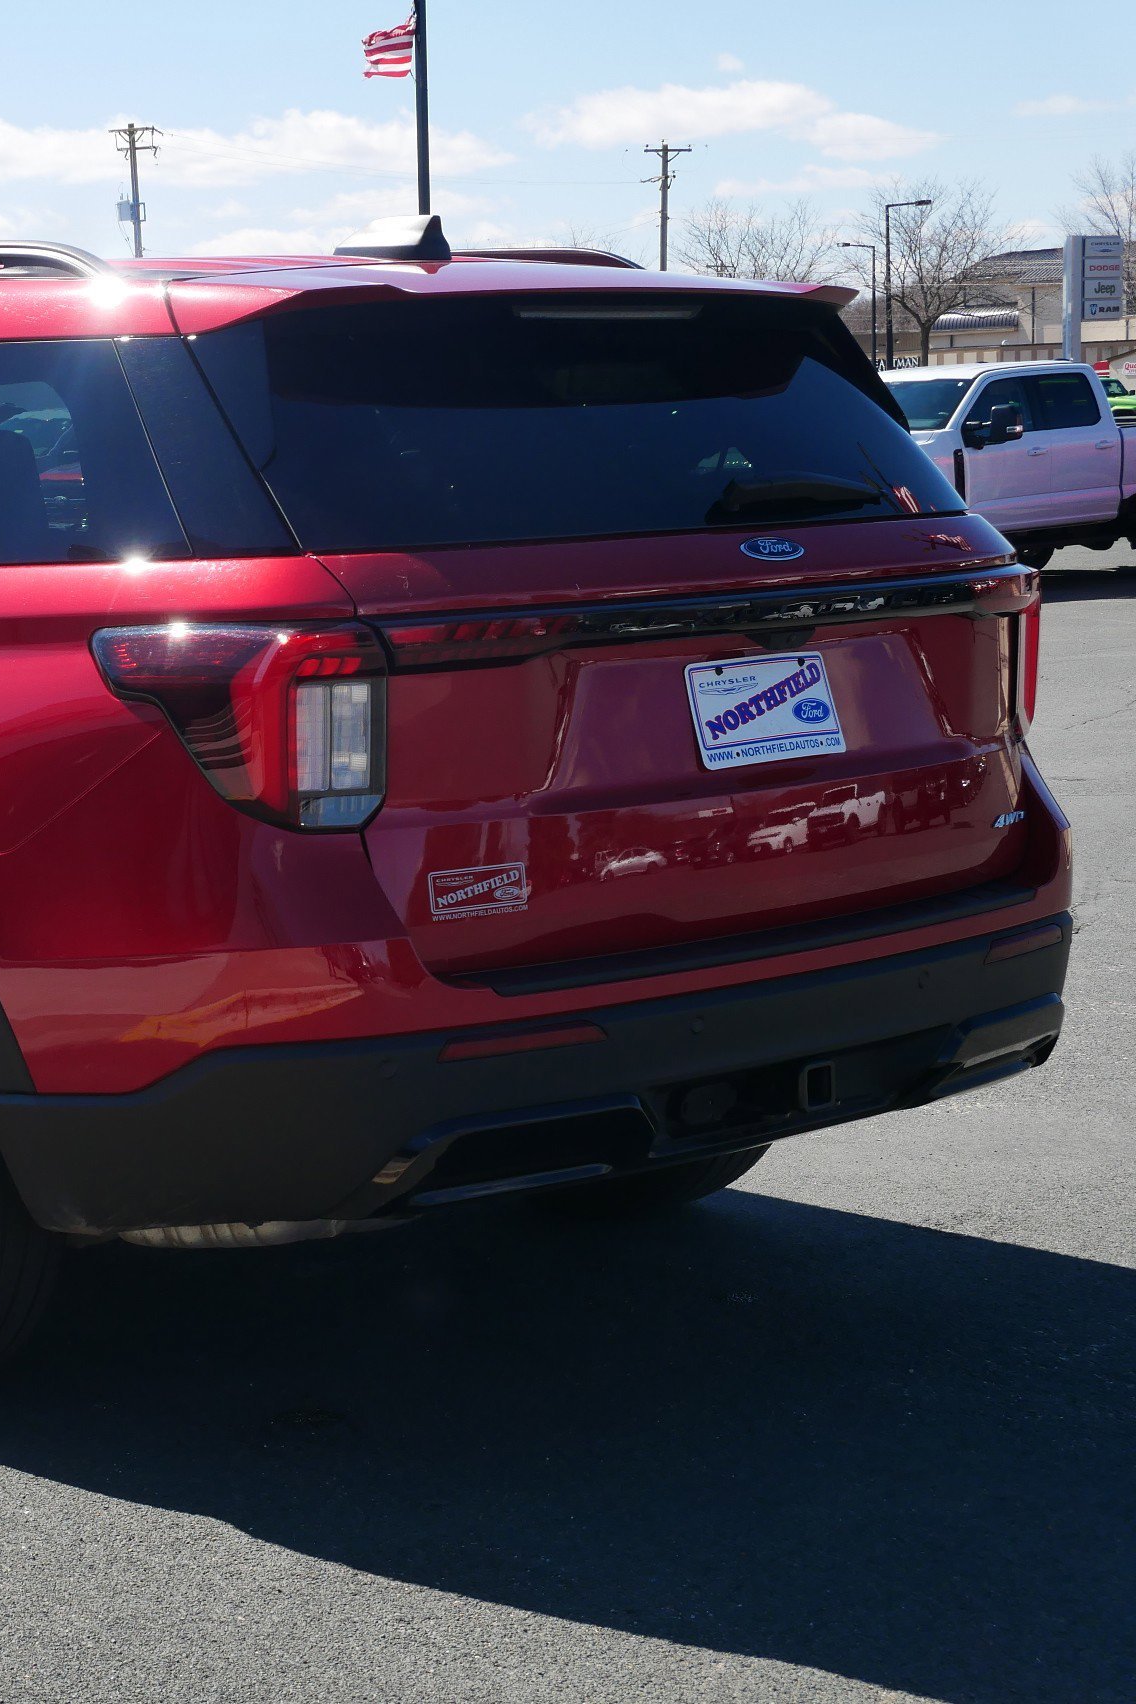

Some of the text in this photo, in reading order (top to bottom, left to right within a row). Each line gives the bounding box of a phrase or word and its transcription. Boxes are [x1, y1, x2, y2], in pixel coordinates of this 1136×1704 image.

[1089, 264, 1120, 272] DODGE
[1094, 281, 1116, 295] Jeep
[1098, 305, 1120, 313] RAM
[757, 539, 793, 554] Ford
[698, 675, 756, 689] CHRYSLER
[705, 662, 821, 741] NORTHFIELD
[801, 701, 824, 719] Ford
[435, 875, 473, 883] CHRYSLER
[436, 869, 520, 908] NORTHFIELD
[431, 905, 528, 922] WWW.NORTHFIELDAUTOS.COM
